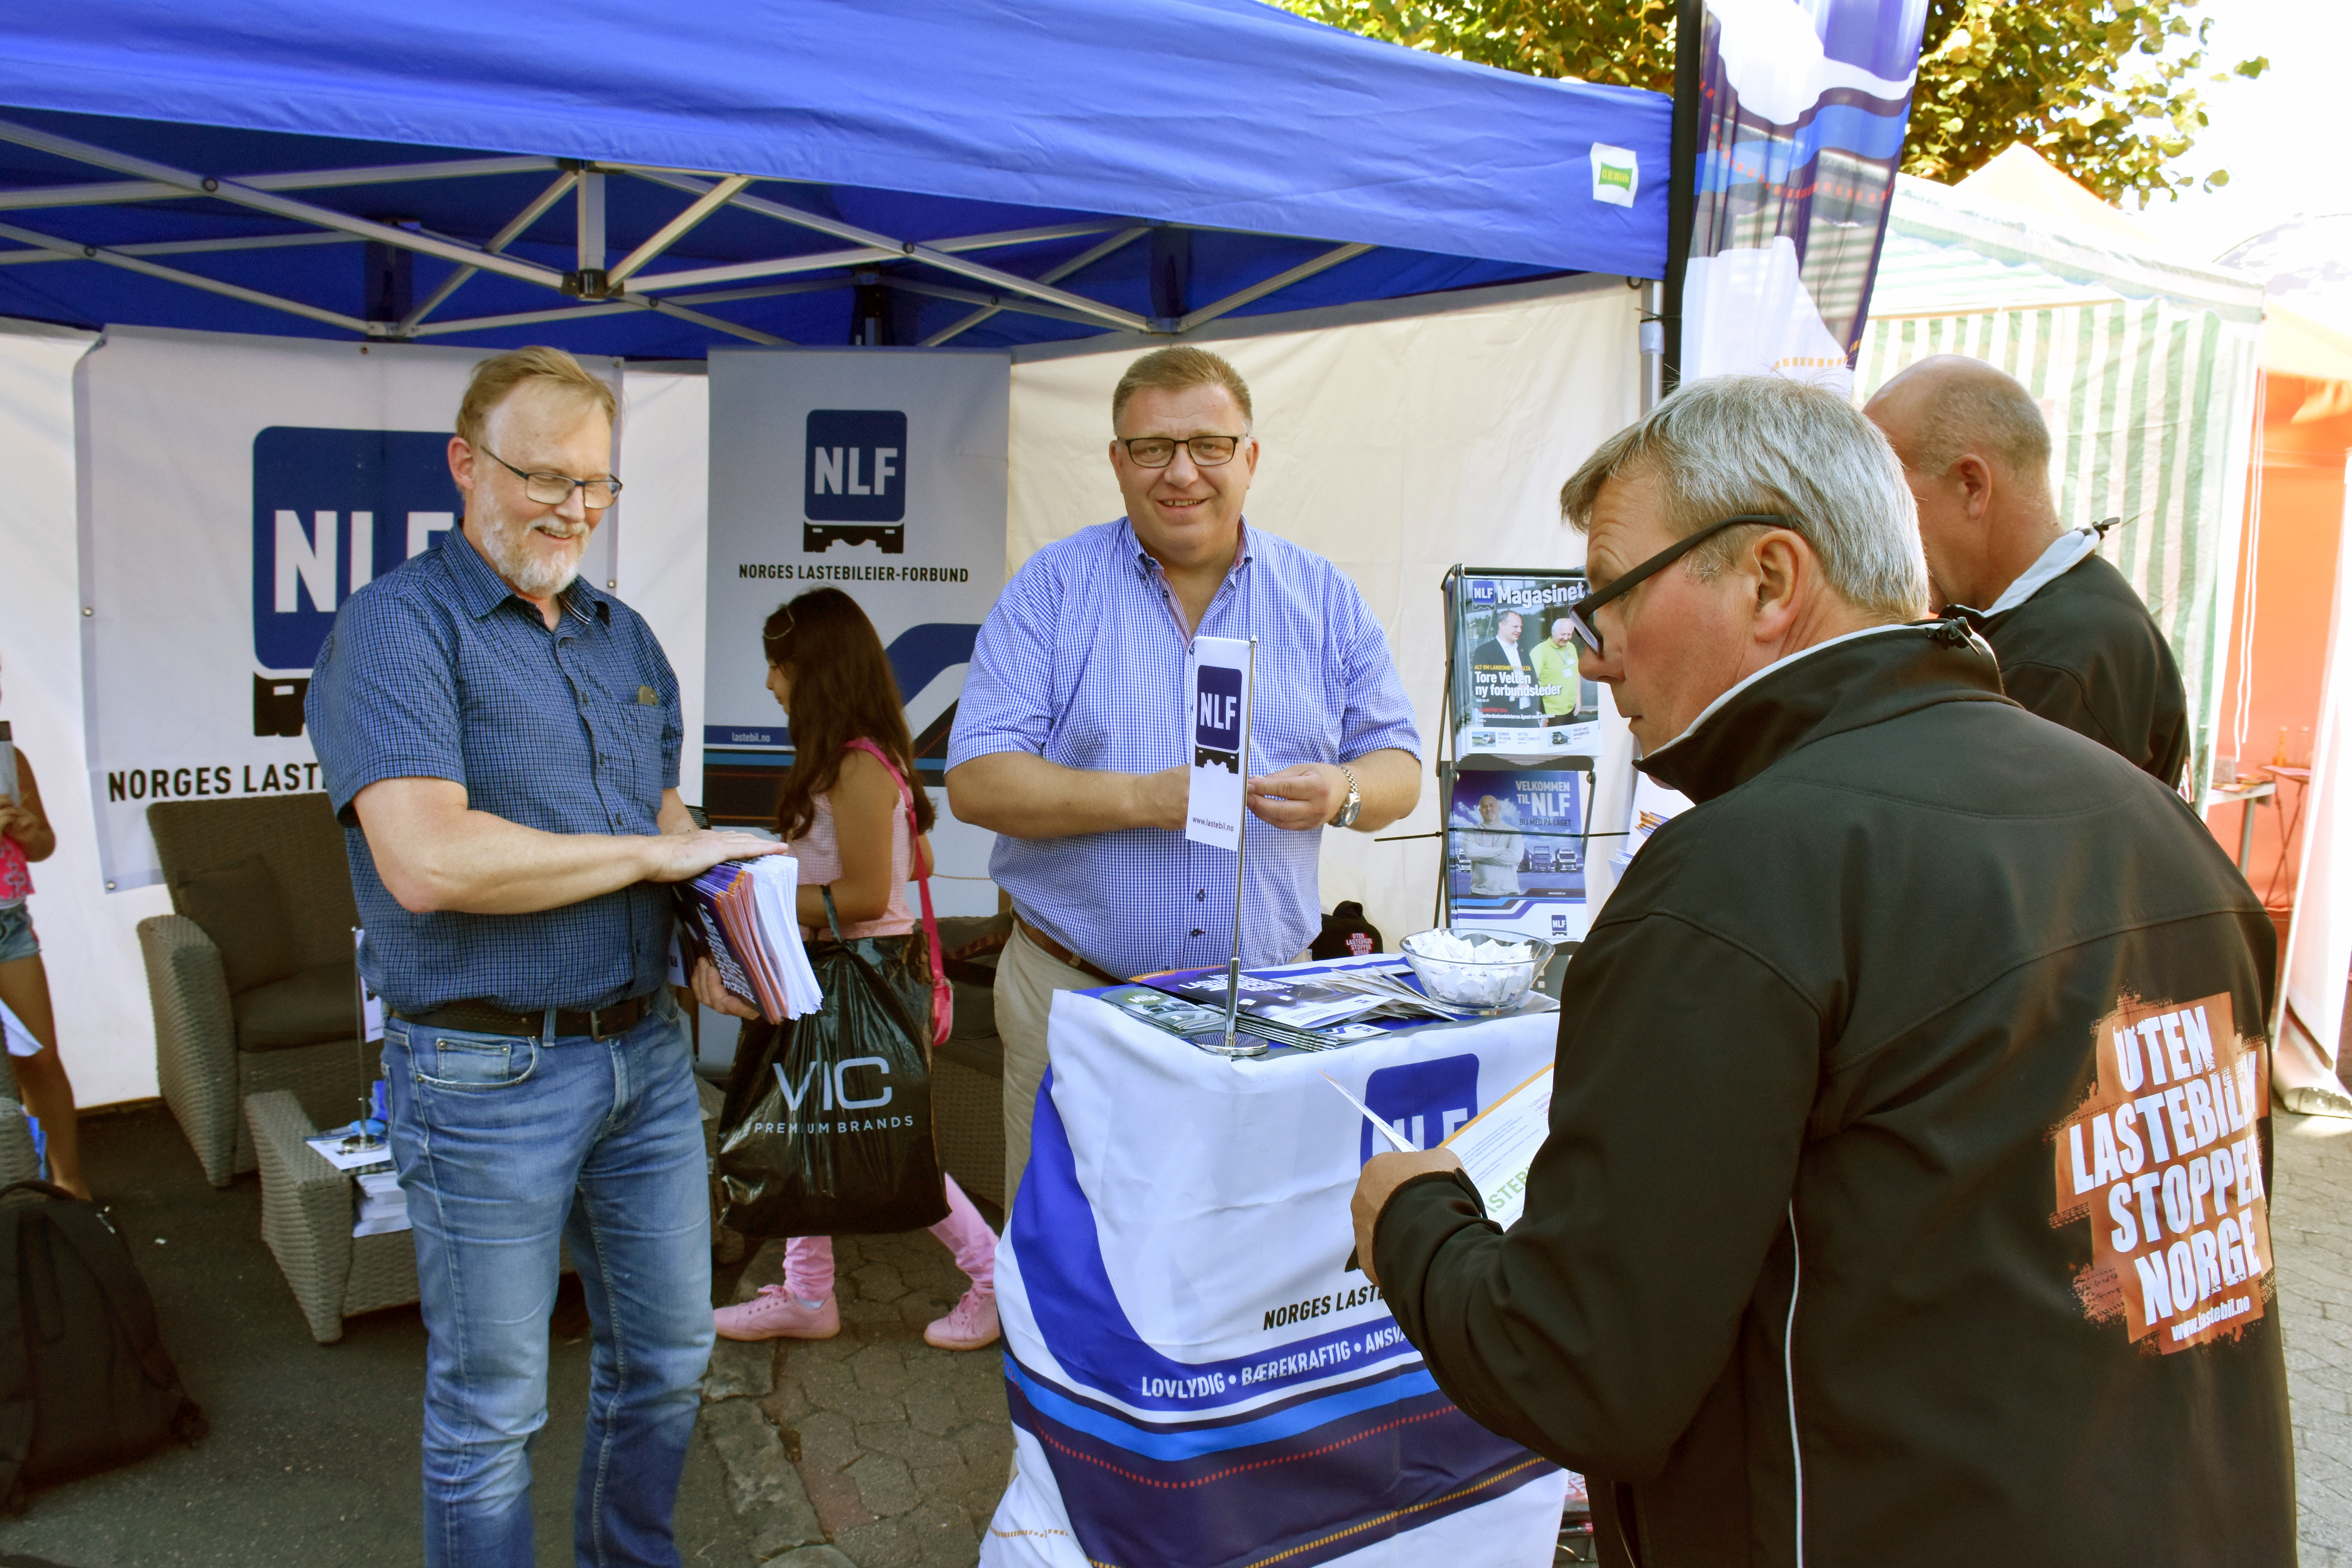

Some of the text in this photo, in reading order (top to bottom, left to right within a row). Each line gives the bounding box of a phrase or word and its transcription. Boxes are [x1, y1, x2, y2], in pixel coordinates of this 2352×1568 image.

[814, 447, 898, 495] NLF
[739, 564, 968, 582] NORGES LASTEBILEIER-FORBUND
[1474, 582, 1585, 608] NLF Magasinet
[1474, 671, 1532, 684] Tore Velten
[1475, 684, 1562, 698] ny forbundsleder
[1200, 692, 1237, 731] NLF
[732, 732, 771, 742] lastebil.no
[108, 762, 326, 802] NORGES LAST
[1515, 781, 1570, 792] VELKOMMEN
[1517, 792, 1570, 817] TIL NLF
[1192, 817, 1234, 832] www.lastebil.no
[1544, 817, 1552, 826] PÅ
[1552, 920, 1566, 928] NLF
[2113, 1005, 2216, 1092] UTEN
[773, 1056, 892, 1111] VIC
[754, 1116, 914, 1134] PREMUM BRANDS
[1485, 1166, 1530, 1213] STEB
[2108, 1133, 2264, 1253] STOPPER
[2134, 1207, 2262, 1326] NORGE
[1263, 1295, 1331, 1331] NORGES
[2171, 1295, 2250, 1342] www.lastebil.no
[1142, 1372, 1225, 1399] LOVLYDIG
[1241, 1340, 1351, 1386] BÆREKRAFTIG
